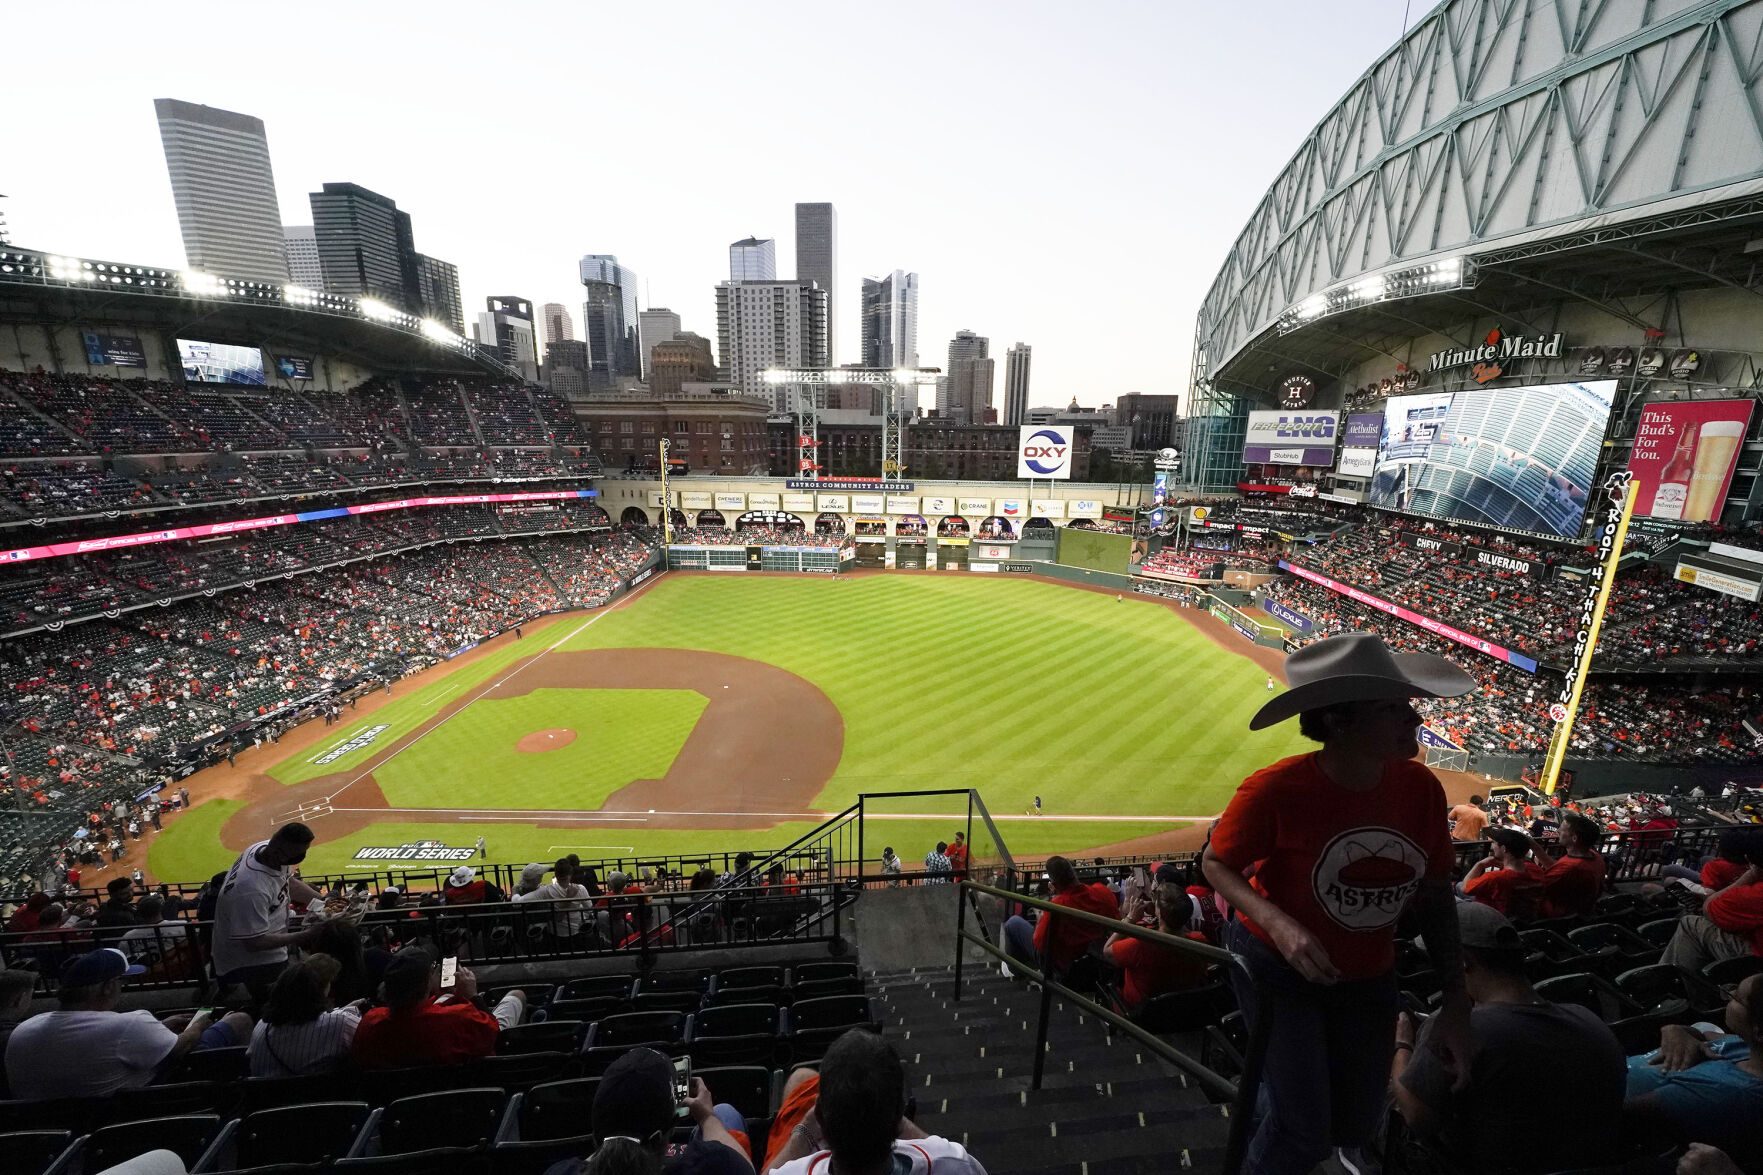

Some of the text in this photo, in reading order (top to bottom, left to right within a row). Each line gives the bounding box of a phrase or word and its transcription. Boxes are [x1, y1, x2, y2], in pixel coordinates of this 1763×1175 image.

[1428, 333, 1561, 372] Minute Maid
[1471, 362, 1502, 384] Park
[1284, 376, 1311, 387] HOUSTON
[1288, 386, 1302, 399] H
[1282, 399, 1307, 408] ASTROS
[1643, 411, 1673, 423] This
[1277, 416, 1335, 438] LNG
[1348, 423, 1379, 434] Methodist
[1640, 424, 1676, 435] Bud's
[1636, 437, 1659, 447] For
[1024, 447, 1067, 458] OXY
[1634, 448, 1660, 460] You.
[1209, 522, 1235, 530] impact
[1243, 525, 1270, 533] impact
[109, 537, 137, 545] OFFICIAL
[1416, 537, 1442, 551] CHEVY
[1477, 551, 1530, 574] SILVERADO
[1681, 571, 1696, 580] smile
[1698, 573, 1753, 592] SmileGeneration.com
[1559, 508, 1620, 704] ROOT 4 THA CHIKIN
[1279, 609, 1303, 627] LEXUS
[1440, 626, 1458, 639] OFFICIAL
[1458, 635, 1470, 643] BEER
[355, 847, 475, 860] WORLD SERIES
[1325, 879, 1425, 908] ASTROS
